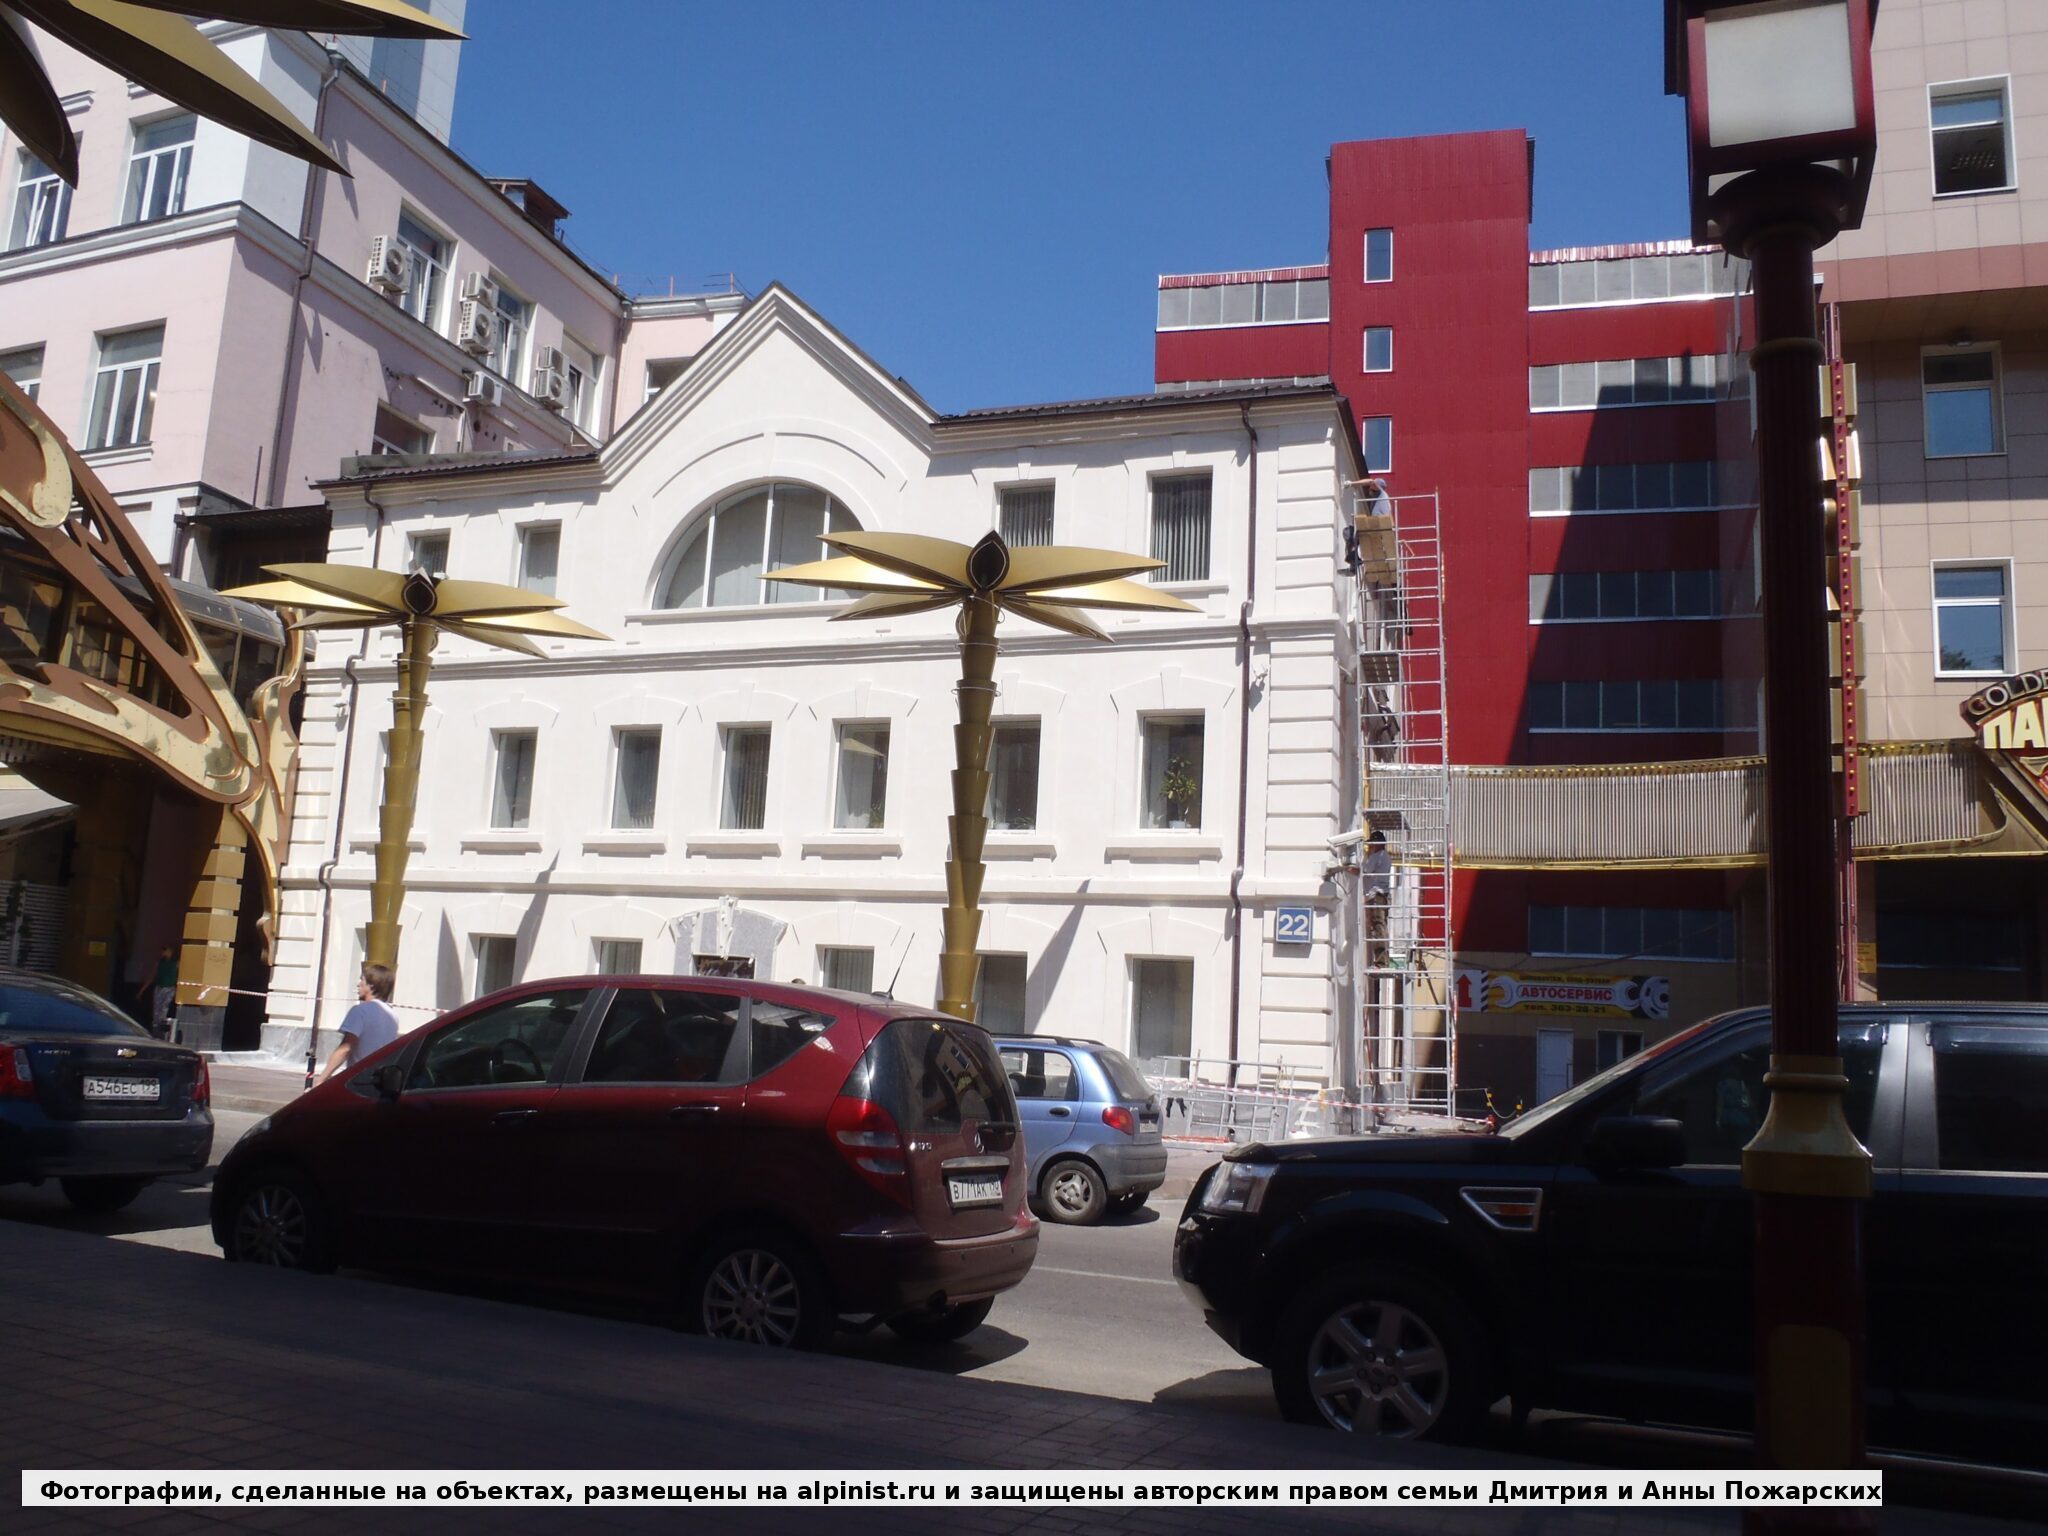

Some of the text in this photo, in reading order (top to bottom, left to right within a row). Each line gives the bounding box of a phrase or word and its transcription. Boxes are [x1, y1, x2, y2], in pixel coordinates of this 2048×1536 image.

[1983, 697, 2048, 749] ПА
[1279, 914, 1308, 935] 22
[1521, 987, 1613, 1001] АВТОСЕРВИС
